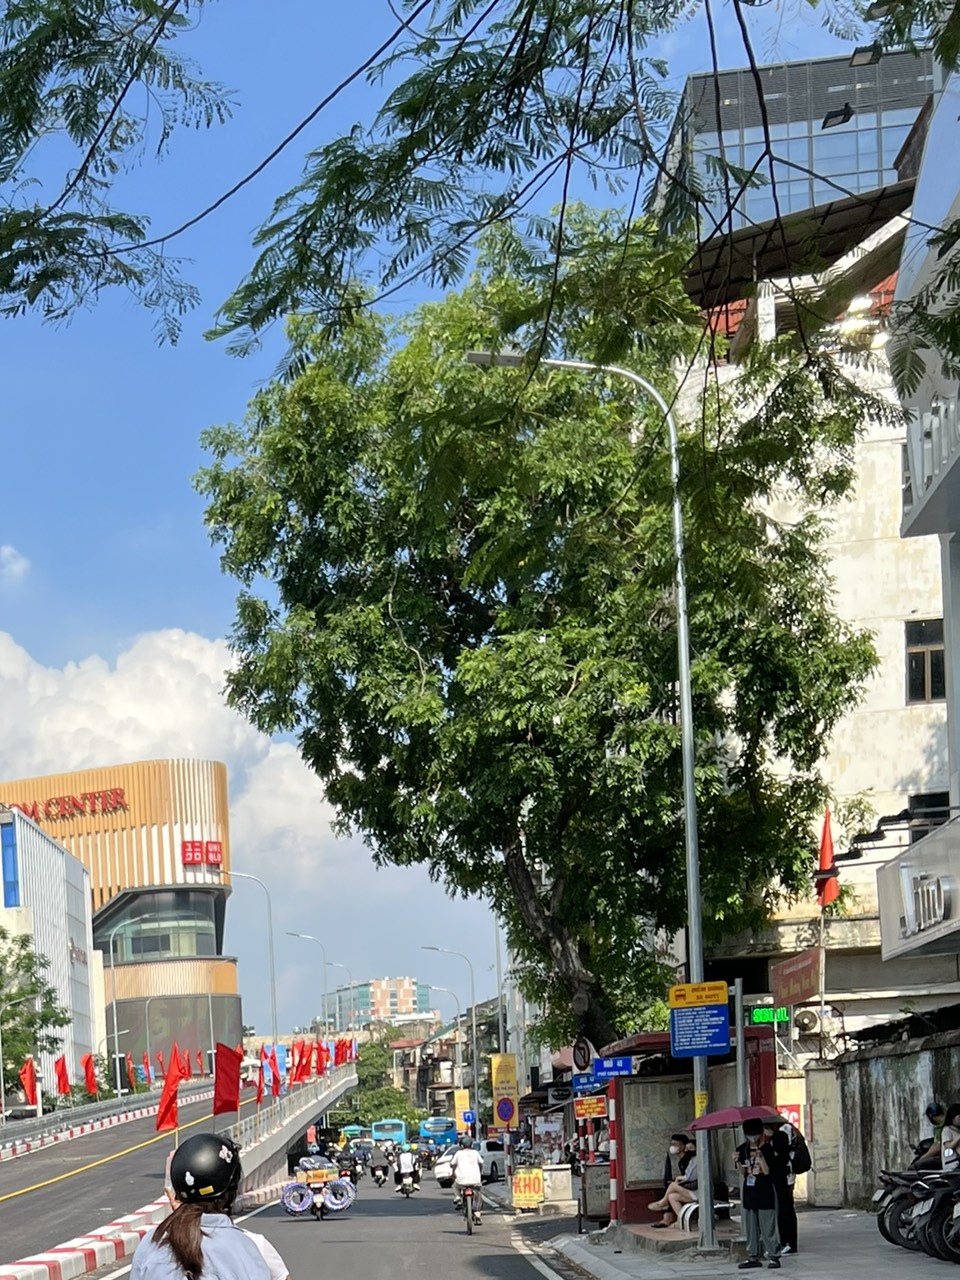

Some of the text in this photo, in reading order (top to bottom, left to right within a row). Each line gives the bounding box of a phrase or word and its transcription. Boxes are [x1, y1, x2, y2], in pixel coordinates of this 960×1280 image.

[44, 788, 126, 817] CENTER
[208, 843, 220, 852] UNI
[208, 852, 222, 863] QLO
